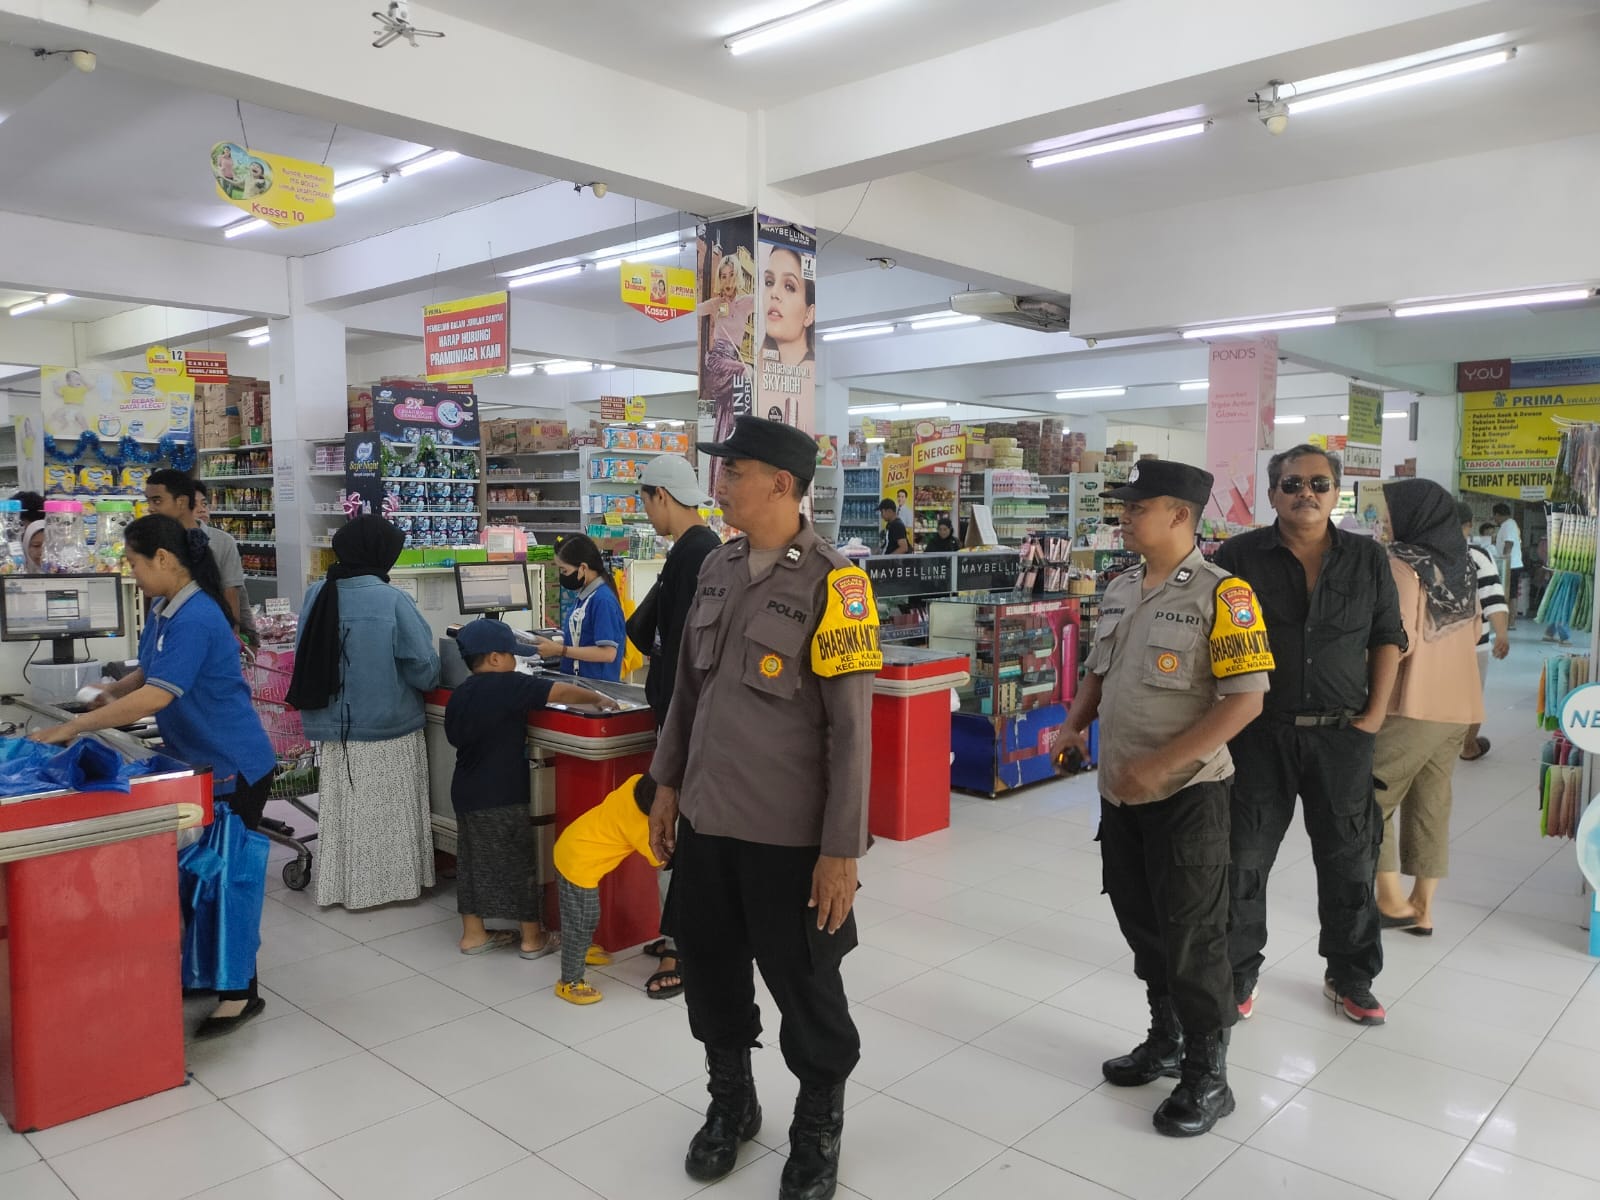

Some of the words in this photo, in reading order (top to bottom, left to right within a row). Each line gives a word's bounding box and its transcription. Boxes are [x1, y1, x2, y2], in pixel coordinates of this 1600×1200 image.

[252, 202, 288, 219] Kassa
[292, 210, 305, 221] 10
[676, 286, 694, 294] PRIMA
[645, 305, 669, 317] Kassa
[671, 308, 677, 318] 11
[439, 333, 460, 348] HARAP
[462, 328, 491, 345] HUBUNGI
[171, 350, 183, 360] 12
[430, 346, 479, 367] PRAMUNIAGA
[480, 343, 501, 360] KAMI
[1212, 347, 1256, 361] POND'S
[764, 374, 781, 391] SKY
[783, 376, 801, 394] HIGH
[733, 374, 744, 416] INE
[1512, 394, 1565, 407] PRIMA
[406, 399, 422, 410] 2X
[917, 444, 963, 462] ENERGEN
[1465, 460, 1501, 468] TANGGA
[1504, 460, 1527, 468] NAIK
[887, 468, 910, 482] No.1
[1466, 474, 1505, 488] TEMPAT
[1506, 473, 1554, 486] PENITIPA
[870, 565, 947, 579] MAYBELLINE
[961, 562, 1021, 574] MAYBELLIN
[766, 600, 807, 625] POLRI
[1154, 611, 1200, 626] POLRI
[1569, 709, 1600, 729] NE
